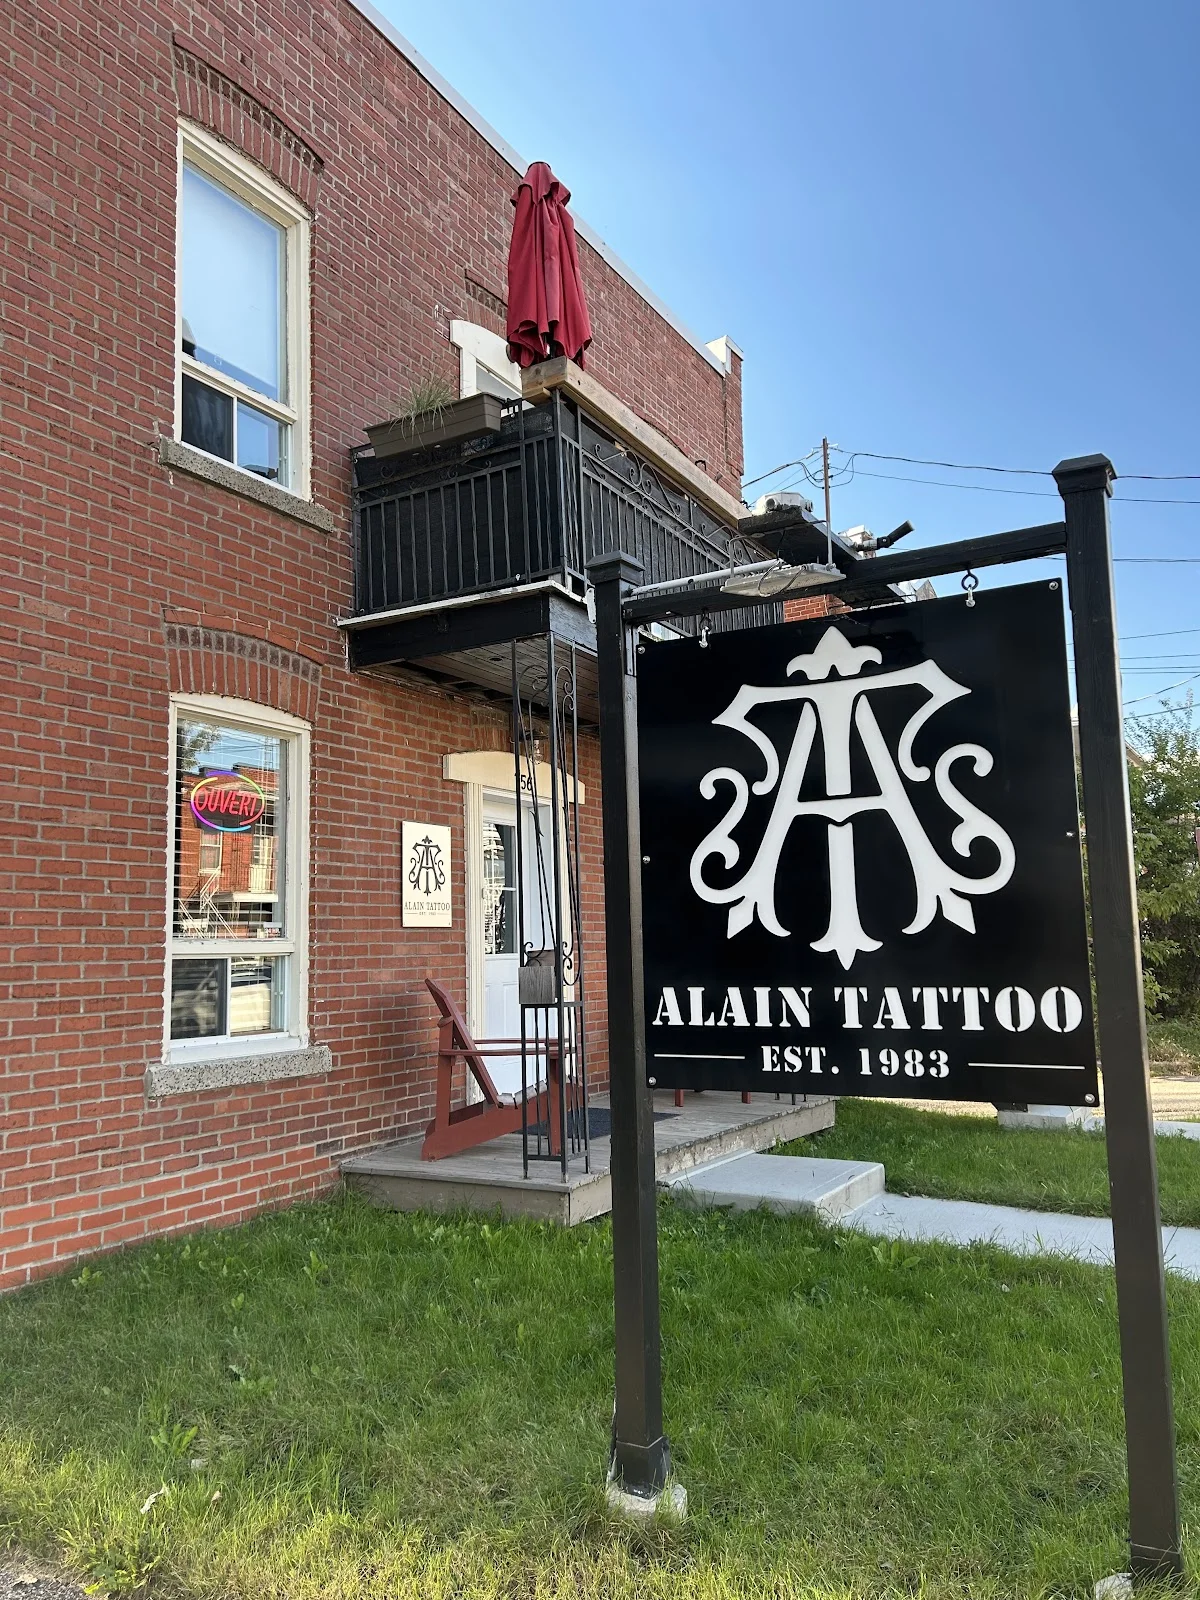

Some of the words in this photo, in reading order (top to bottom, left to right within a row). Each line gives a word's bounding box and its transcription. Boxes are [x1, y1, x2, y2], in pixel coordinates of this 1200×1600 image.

[195, 787, 257, 817] OUVERT
[404, 901, 424, 910] ALAIN
[426, 902, 450, 911] TATTOO
[652, 986, 812, 1028] ALAIN
[833, 986, 1083, 1033] TATTOO
[761, 1045, 840, 1075] EST.
[858, 1048, 950, 1078] 1983
